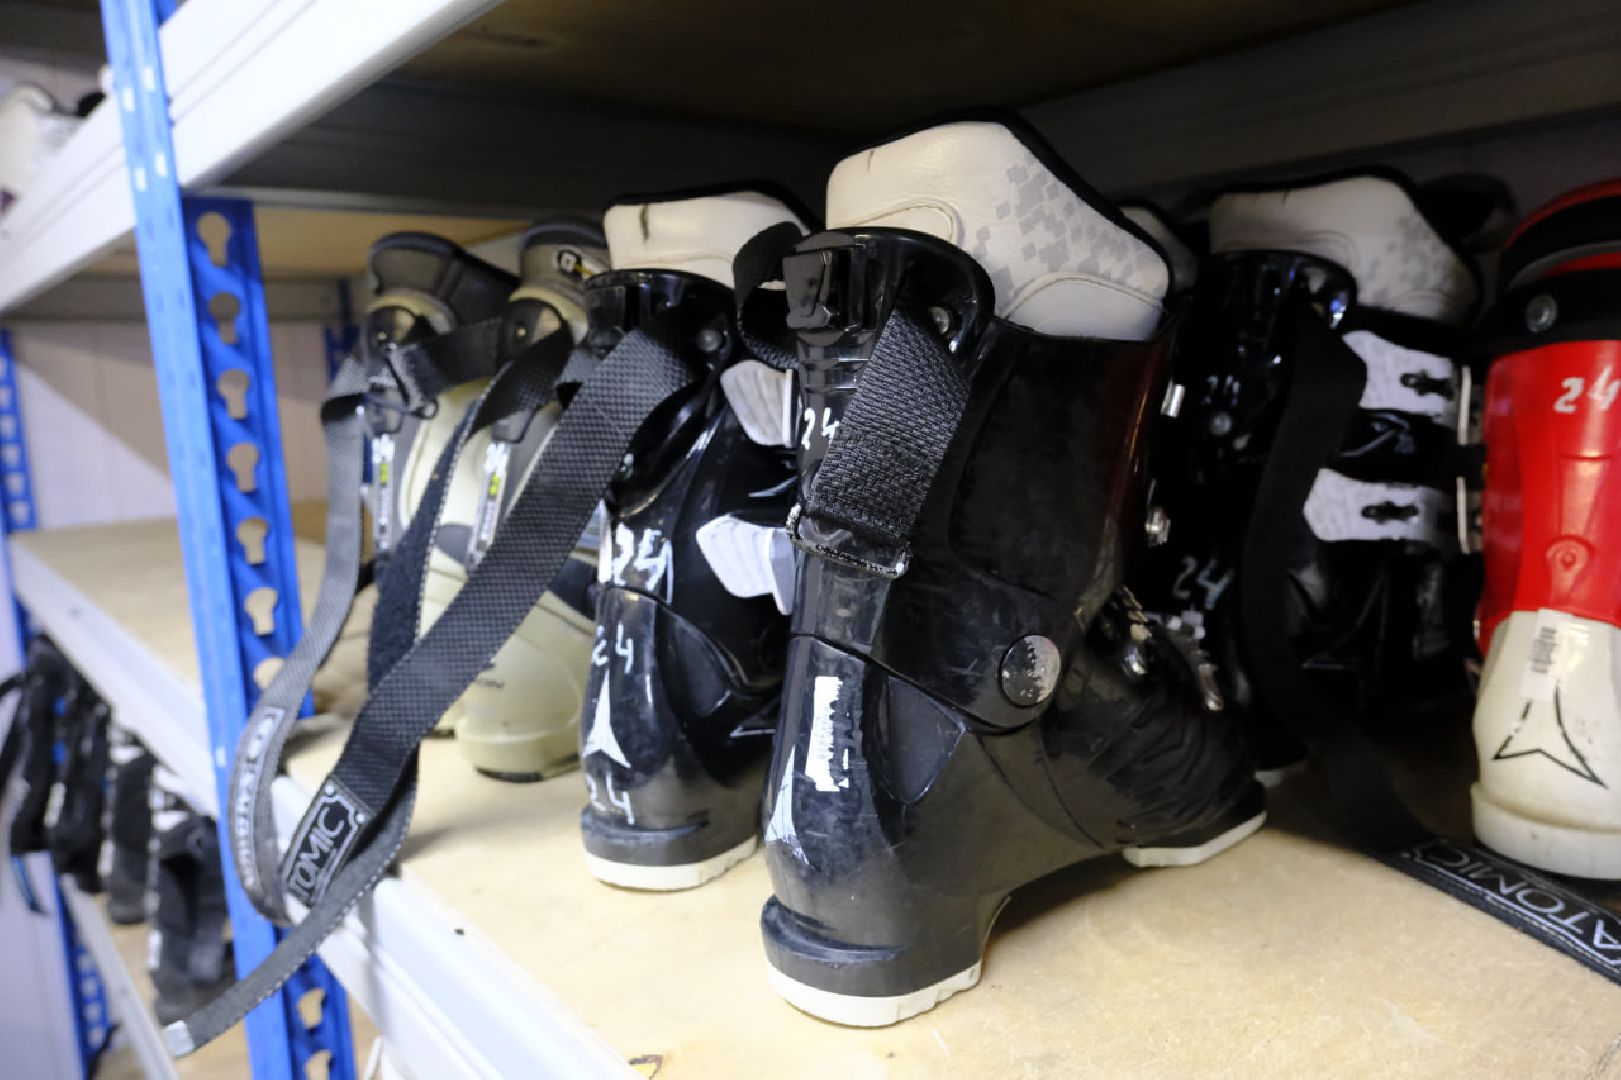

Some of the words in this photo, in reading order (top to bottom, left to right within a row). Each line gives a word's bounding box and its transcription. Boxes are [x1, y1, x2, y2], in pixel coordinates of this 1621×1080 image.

[1554, 366, 1620, 414] 24
[801, 407, 840, 451] 24
[612, 522, 669, 593] 24
[1171, 555, 1235, 611] 24
[592, 622, 635, 675] 24
[289, 806, 346, 900] TOMIC
[1428, 849, 1621, 950] ATOMIC
